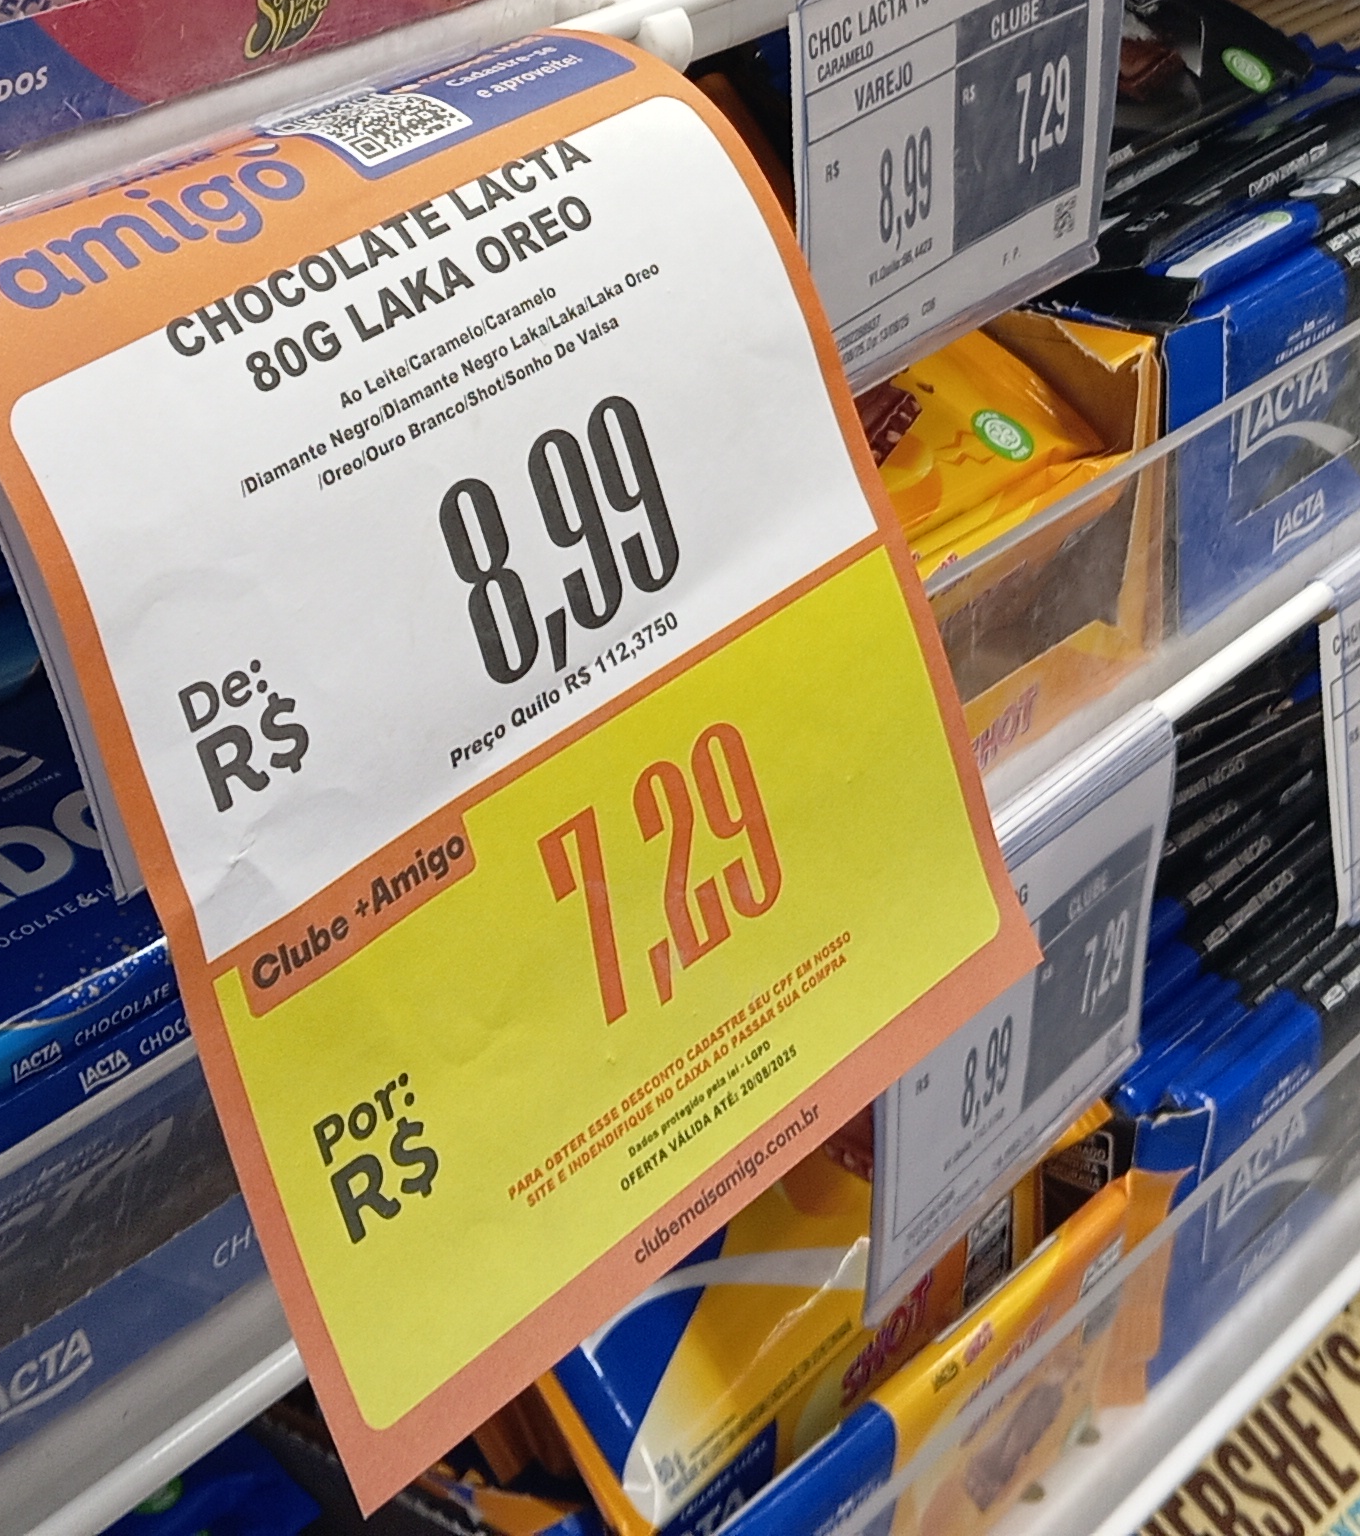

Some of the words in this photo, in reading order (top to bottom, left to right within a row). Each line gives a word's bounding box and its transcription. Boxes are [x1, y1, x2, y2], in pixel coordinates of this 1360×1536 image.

[444, 44, 558, 88] Cadastre-se
[490, 53, 584, 93] aproveite!
[808, 13, 854, 62] CHOC
[817, 41, 875, 83] CARAMELO
[854, 61, 914, 112] VAREJO
[1015, 53, 1071, 173] 7,29
[165, 199, 452, 358] CHOCOLATE
[452, 137, 592, 220] LACTA
[878, 124, 933, 252] 8,99
[245, 319, 343, 393] 80G
[344, 256, 476, 343] LAKA
[475, 195, 594, 275] OREO
[339, 389, 363, 409] Ao
[363, 283, 557, 397] Leite/Caramelo/Caramelo
[240, 436, 328, 498] /Diamante
[328, 370, 461, 447] Negro/Diamante
[460, 344, 509, 376] Negro
[507, 277, 626, 353] Laka/Laka/Laka
[625, 262, 661, 289] Oreo
[317, 432, 407, 491] /Oreo/Ouro
[408, 352, 553, 441] Branco/Shot/Sonho
[552, 337, 578, 360] De
[577, 313, 621, 346] Valsa
[1238, 360, 1330, 464] LACTA
[438, 395, 680, 685] 8,99
[1272, 488, 1326, 555] LACTA
[178, 658, 269, 733] De:
[449, 723, 508, 769] Preço
[510, 683, 561, 730] Quilo
[564, 663, 592, 695] R$
[594, 610, 679, 674] 112,3750
[195, 691, 310, 813] R$
[251, 904, 351, 994] Clube
[354, 831, 469, 922] +Amigo
[536, 720, 783, 1027] 7,29
[1066, 869, 1110, 921] CLUBE
[1080, 909, 1131, 1017] 7,29
[12, 1041, 63, 1084] LACTA
[73, 982, 171, 1048] CHOCOLATE
[77, 1049, 132, 1094] LACTA
[507, 1167, 544, 1202] PARA
[544, 1133, 588, 1172] OBTER
[588, 1107, 620, 1140] ESSE
[621, 1057, 685, 1114] DESCONTO
[686, 1009, 748, 1063] CADASTRE
[748, 992, 772, 1017] SEU
[772, 972, 795, 998] CPF
[795, 957, 814, 979] EM
[813, 931, 853, 966] NOSSO
[526, 1180, 557, 1208] SITE
[557, 1170, 568, 1187] E
[569, 1102, 656, 1176] INDENDIFIQUE
[655, 1087, 675, 1108] NO
[675, 1058, 713, 1097] CAIXA
[711, 1043, 731, 1065] AO
[730, 1007, 777, 1049] PASSAR
[776, 989, 802, 1015] SUA
[800, 953, 848, 994] COMPRA
[960, 1015, 1014, 1130] 8,99
[312, 1070, 418, 1167] Por:
[619, 1147, 669, 1193] OFERTA
[668, 1111, 713, 1155] VÁLIDA
[712, 1088, 741, 1121] ATÉ:
[739, 1044, 799, 1099] 20/08/2025
[627, 1128, 661, 1159] Dados
[660, 1092, 707, 1136] protegido
[705, 1078, 728, 1101] pela
[744, 1039, 773, 1067] LGPD
[328, 1114, 441, 1245] R$
[633, 1101, 822, 1266] clubemaisamigo.com.br
